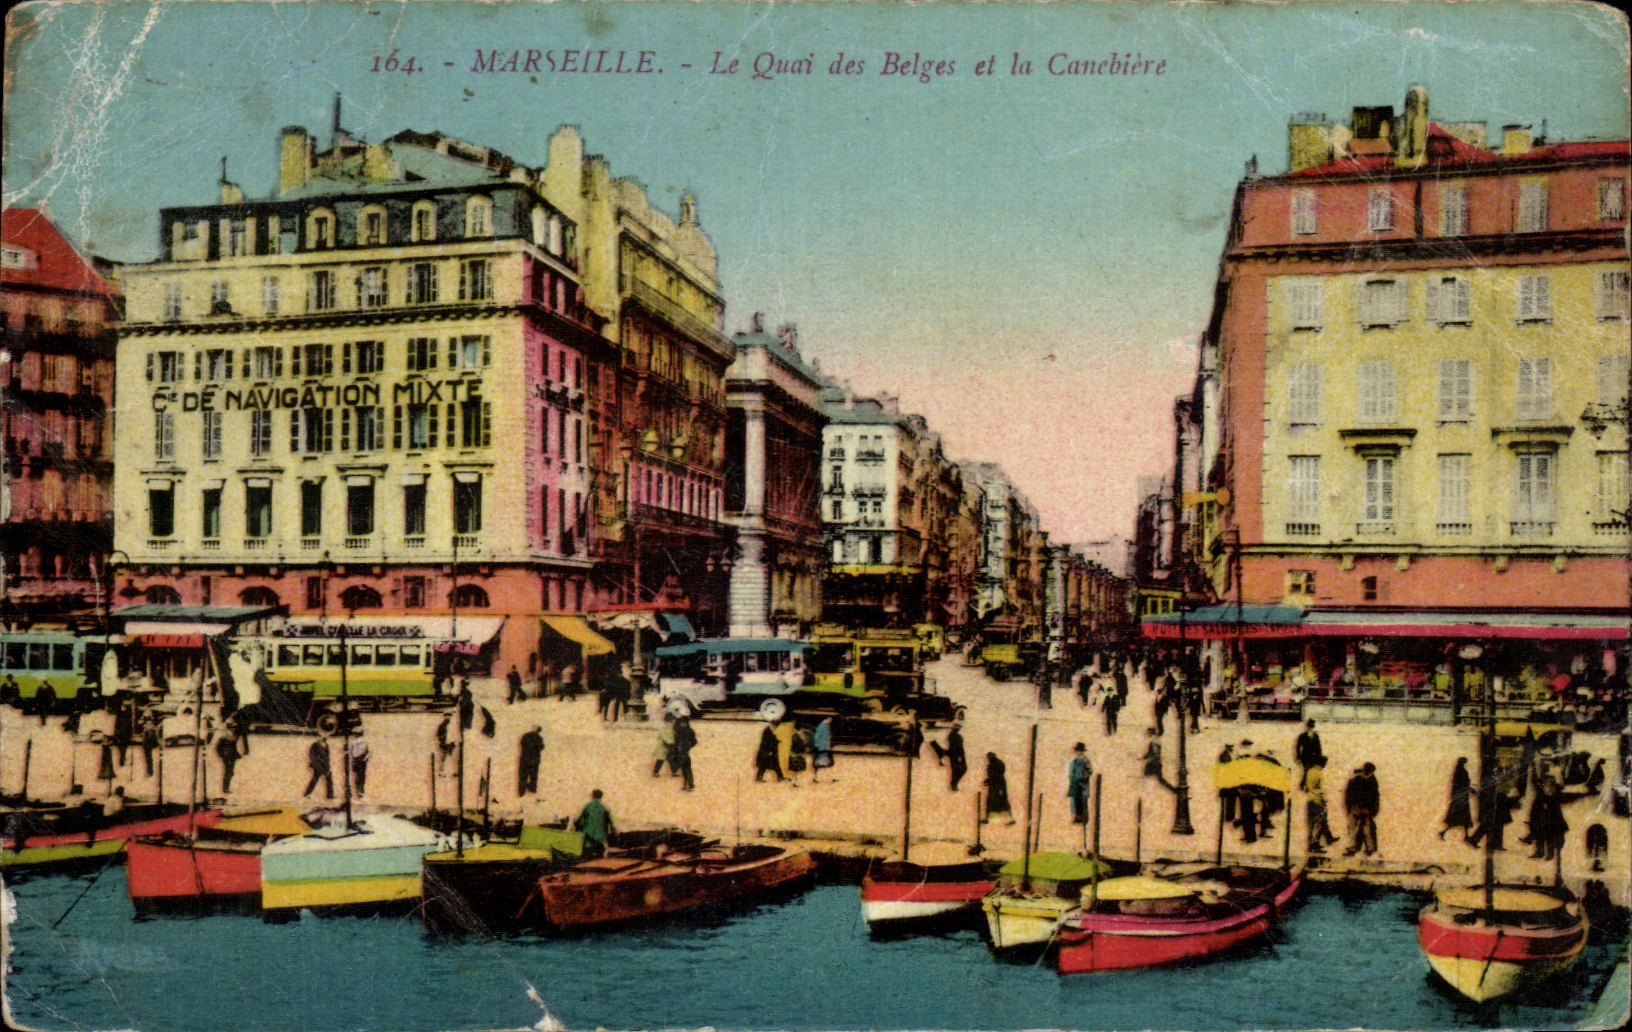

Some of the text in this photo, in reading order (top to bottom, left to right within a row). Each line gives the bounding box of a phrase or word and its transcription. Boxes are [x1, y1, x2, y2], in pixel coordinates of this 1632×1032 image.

[183, 391, 216, 412] DE
[224, 383, 381, 411] NAVIGATION
[393, 378, 484, 404] MIXTE
